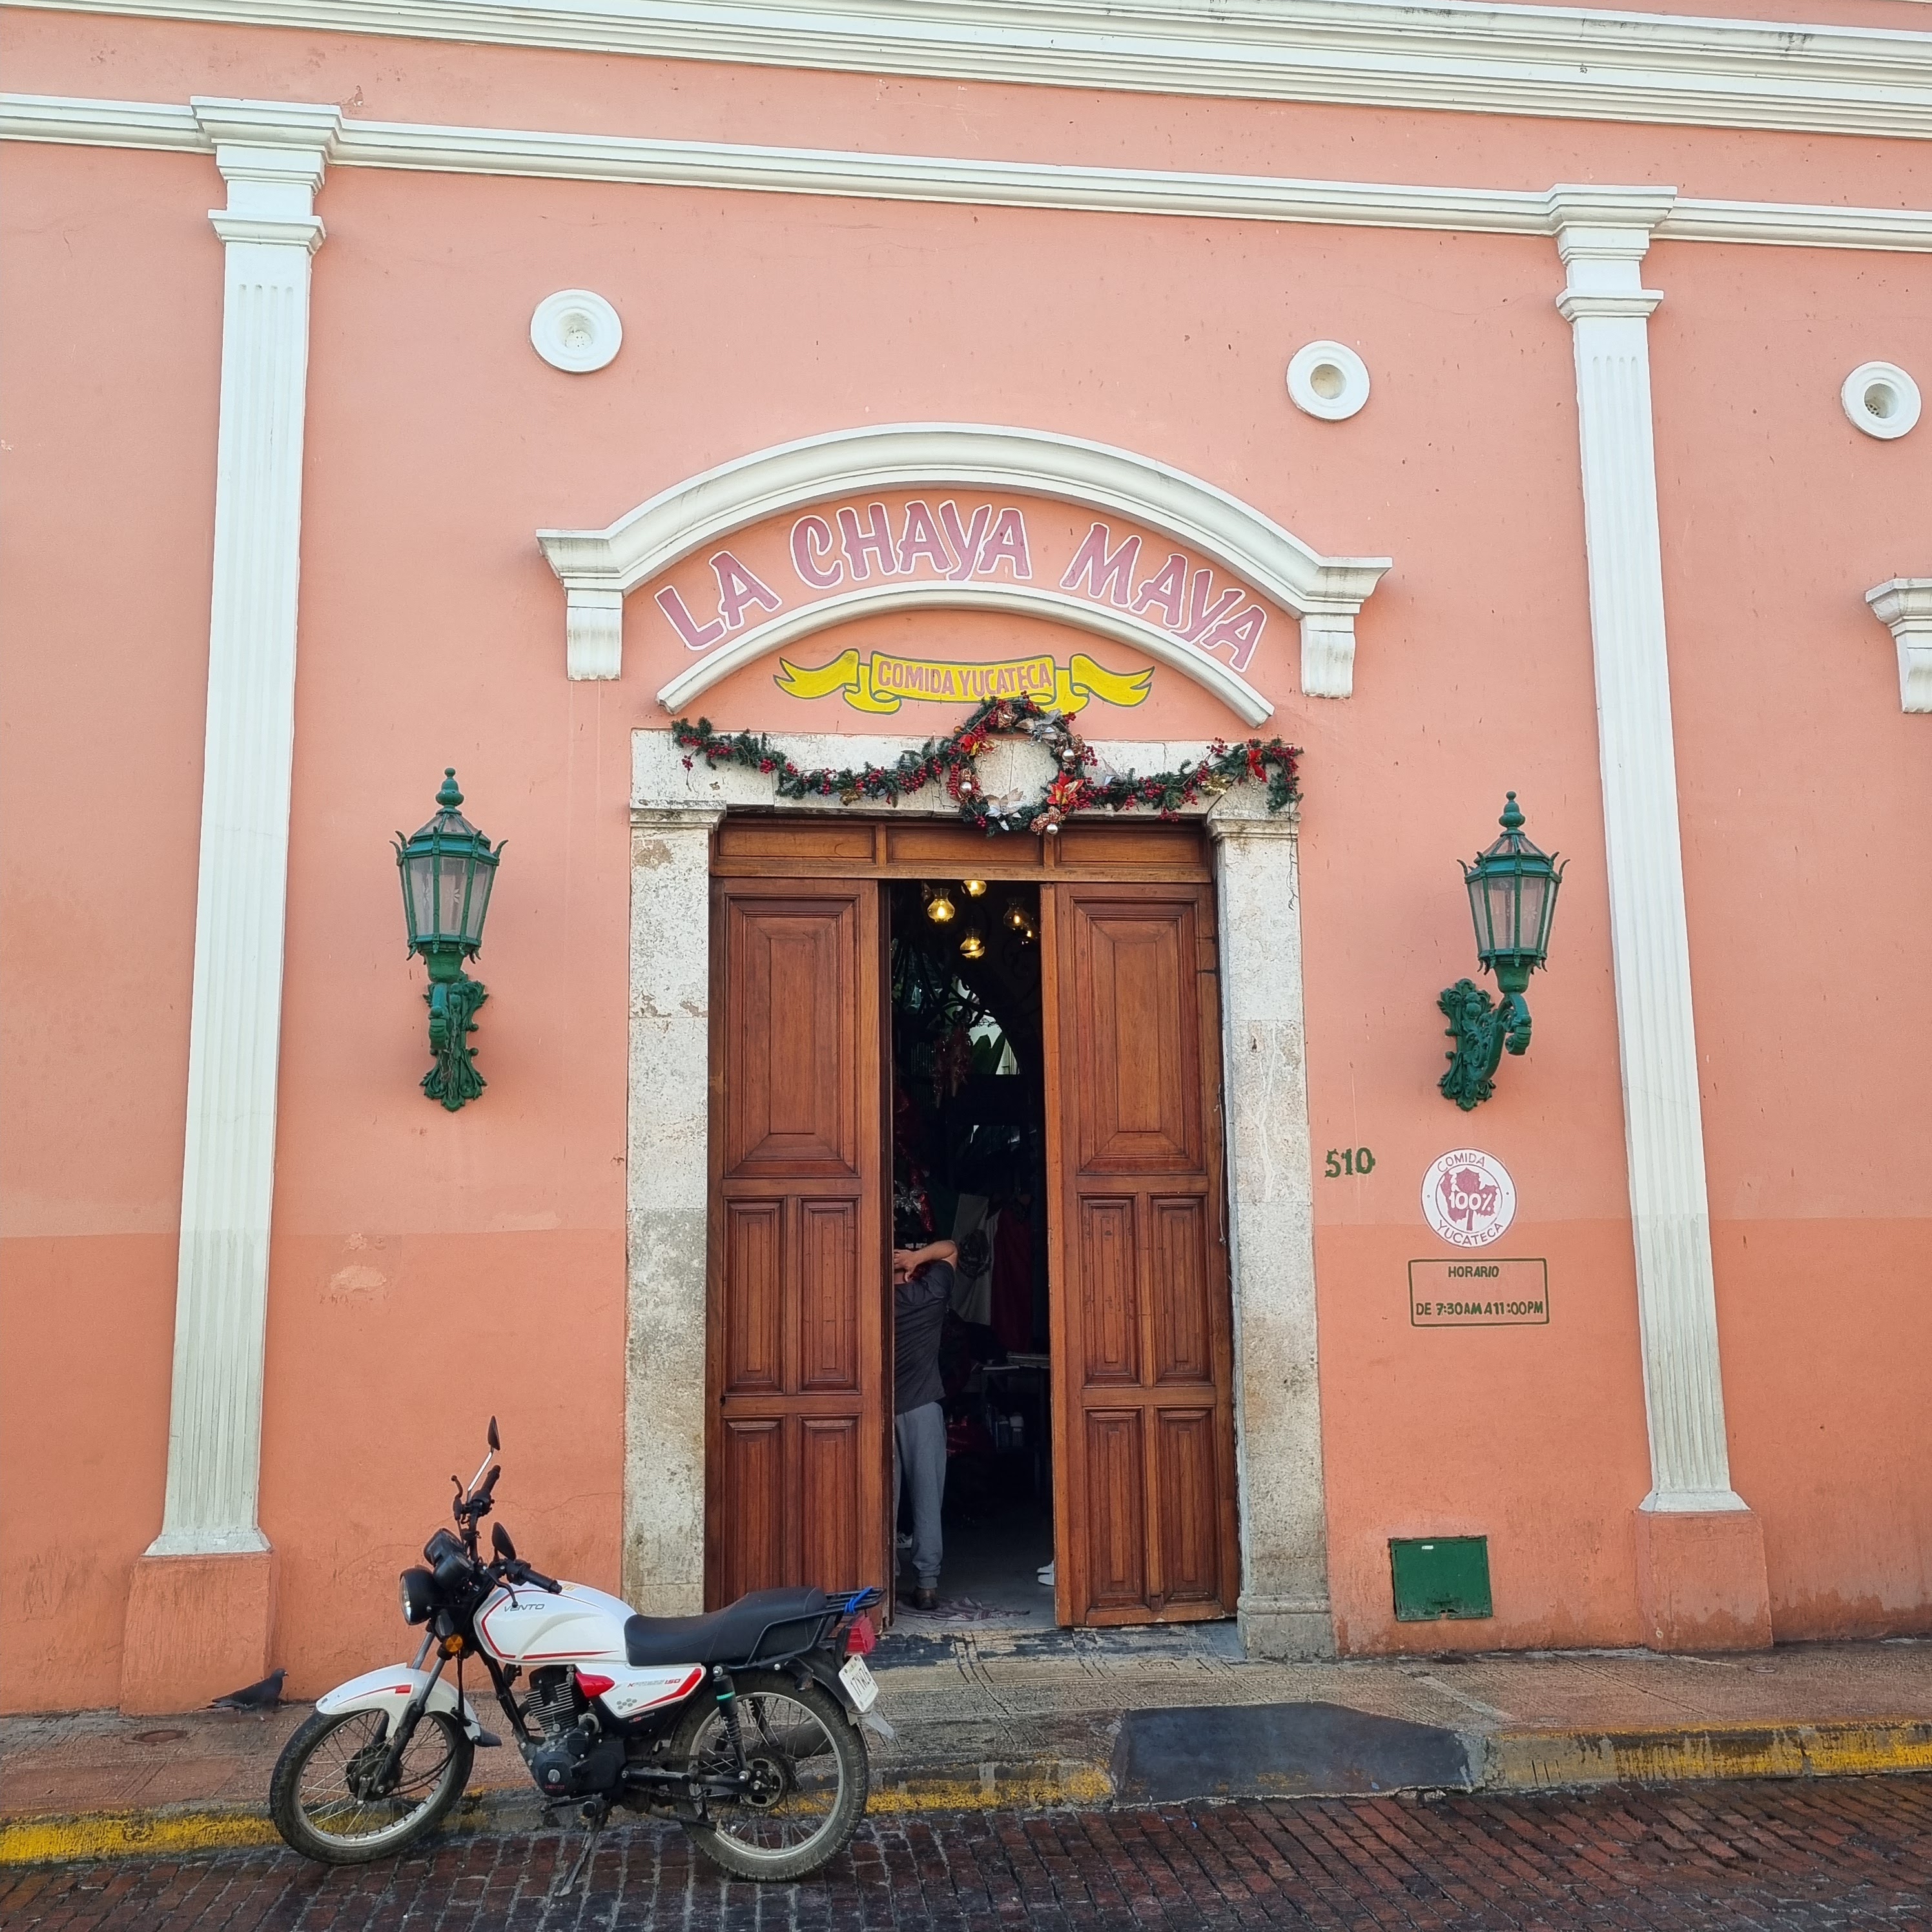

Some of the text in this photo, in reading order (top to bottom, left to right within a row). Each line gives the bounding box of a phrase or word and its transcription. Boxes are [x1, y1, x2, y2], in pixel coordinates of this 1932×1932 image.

[655, 500, 1267, 672] LA CHAYA MAYA
[878, 660, 1053, 697] COMIDA YUCATECA
[1325, 1147, 1376, 1178] 510
[1437, 1153, 1486, 1173] COMIDA
[1448, 1191, 1493, 1211] 100%
[1437, 1219, 1503, 1246] YUCATECA
[1448, 1266, 1500, 1278] HORARIO
[1415, 1302, 1432, 1316] DE
[1435, 1302, 1483, 1316] 7:30AM
[504, 1603, 546, 1612] VENTO
